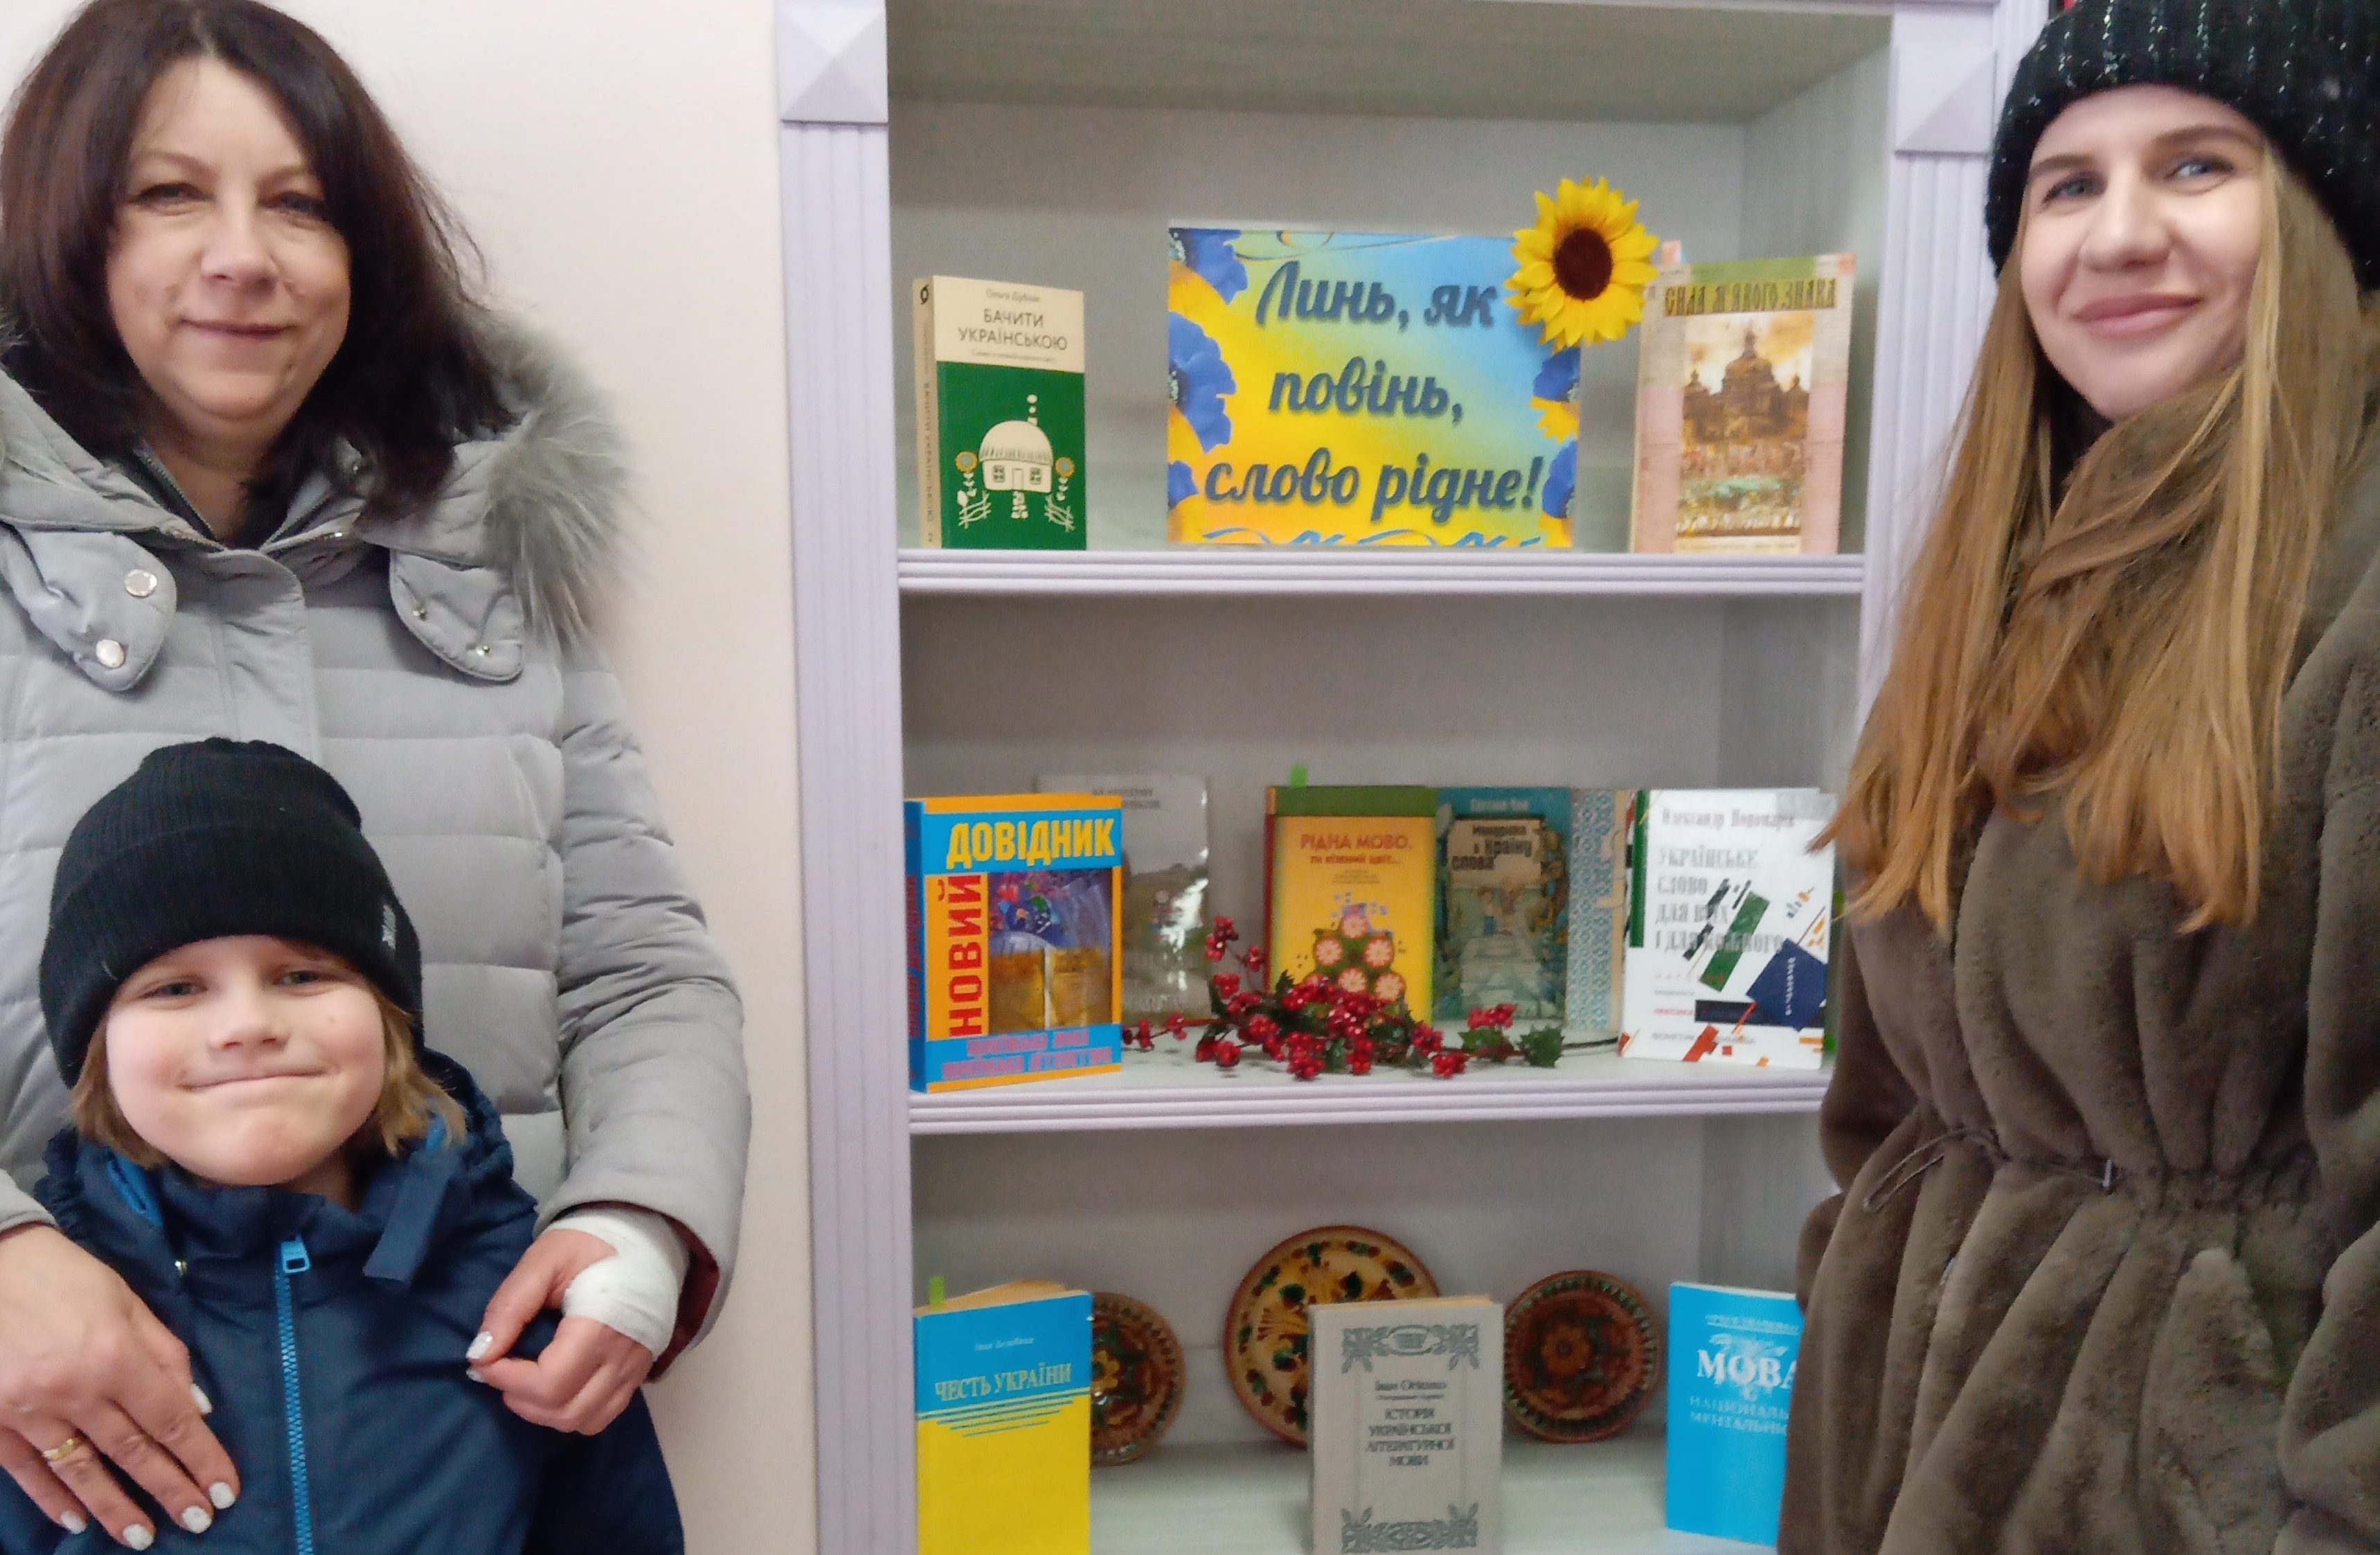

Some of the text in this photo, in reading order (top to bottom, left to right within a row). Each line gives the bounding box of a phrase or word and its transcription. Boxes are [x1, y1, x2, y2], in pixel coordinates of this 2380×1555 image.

[983, 308, 1044, 328] БАЧИТИ
[1254, 259, 1500, 333] Линь, як
[958, 326, 1068, 350] УКРАЇНСЬКОЮ
[1267, 355, 1464, 427] повінь,
[1204, 447, 1546, 526] слово рідне!
[946, 817, 1116, 871] ДОВІДНИК
[1300, 833, 1352, 851] РІДНА
[937, 875, 983, 1038] НОВИЙ
[935, 1362, 1072, 1402] ЧЕСТЬ УКРАЇНИ
